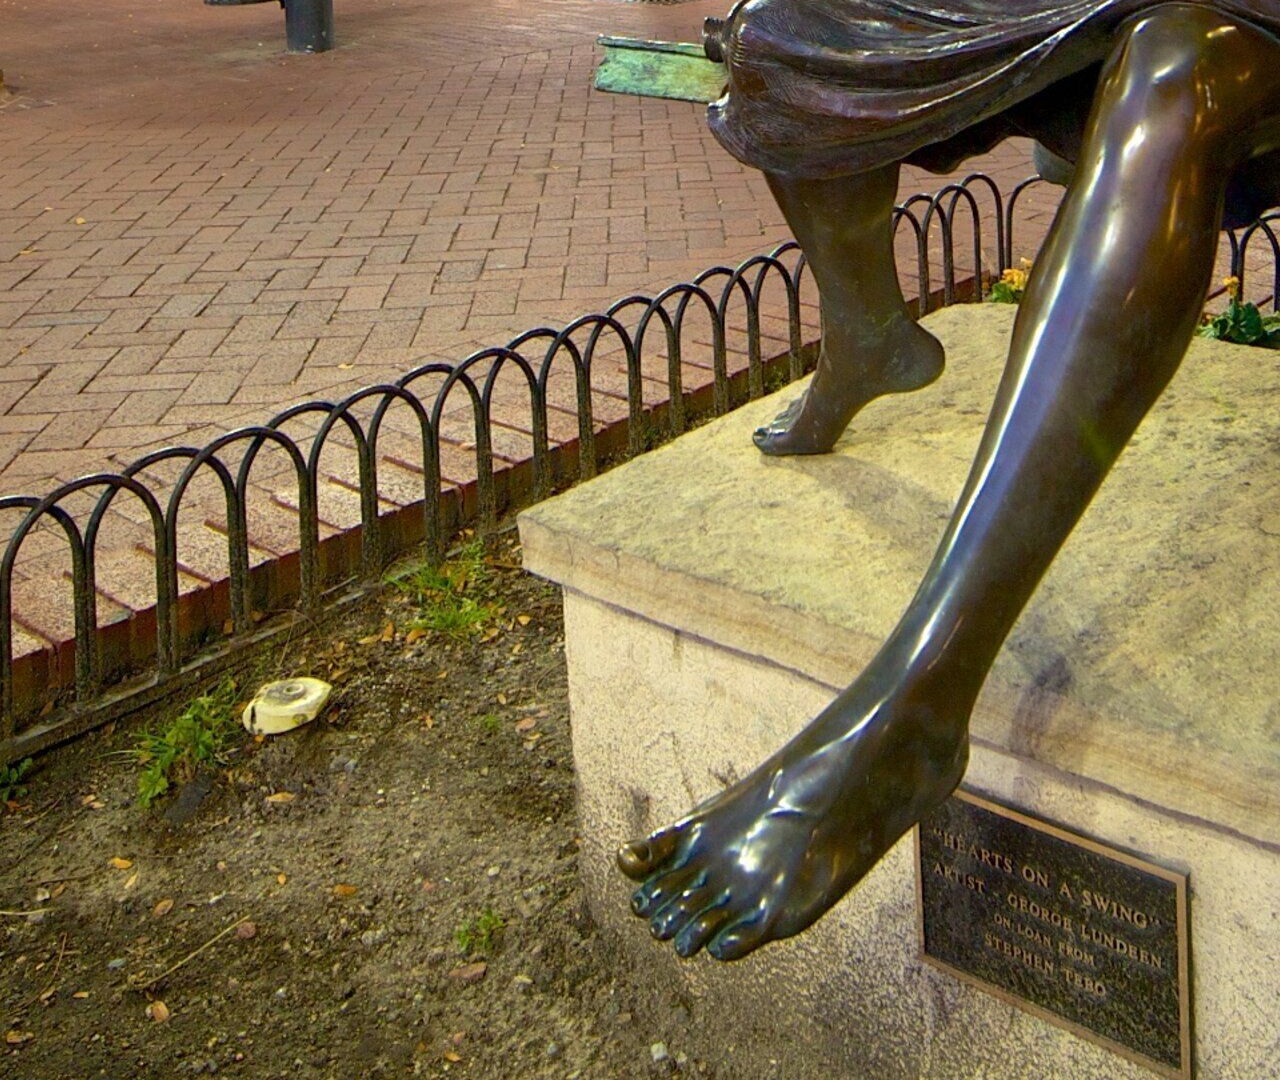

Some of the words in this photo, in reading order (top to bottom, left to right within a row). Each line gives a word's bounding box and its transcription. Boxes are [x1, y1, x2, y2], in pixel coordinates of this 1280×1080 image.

[1022, 865, 1050, 889] ON
[1059, 882, 1072, 899] A
[933, 862, 986, 894] ARTIST
[1006, 892, 1072, 932] GEORGE
[1081, 923, 1163, 969] LUNDEEN
[993, 912, 1011, 929] ON
[1016, 923, 1051, 947] LOAN
[1058, 941, 1095, 966] FROM
[984, 933, 1054, 974] STEPHEN
[1064, 968, 1107, 997] TEBO
